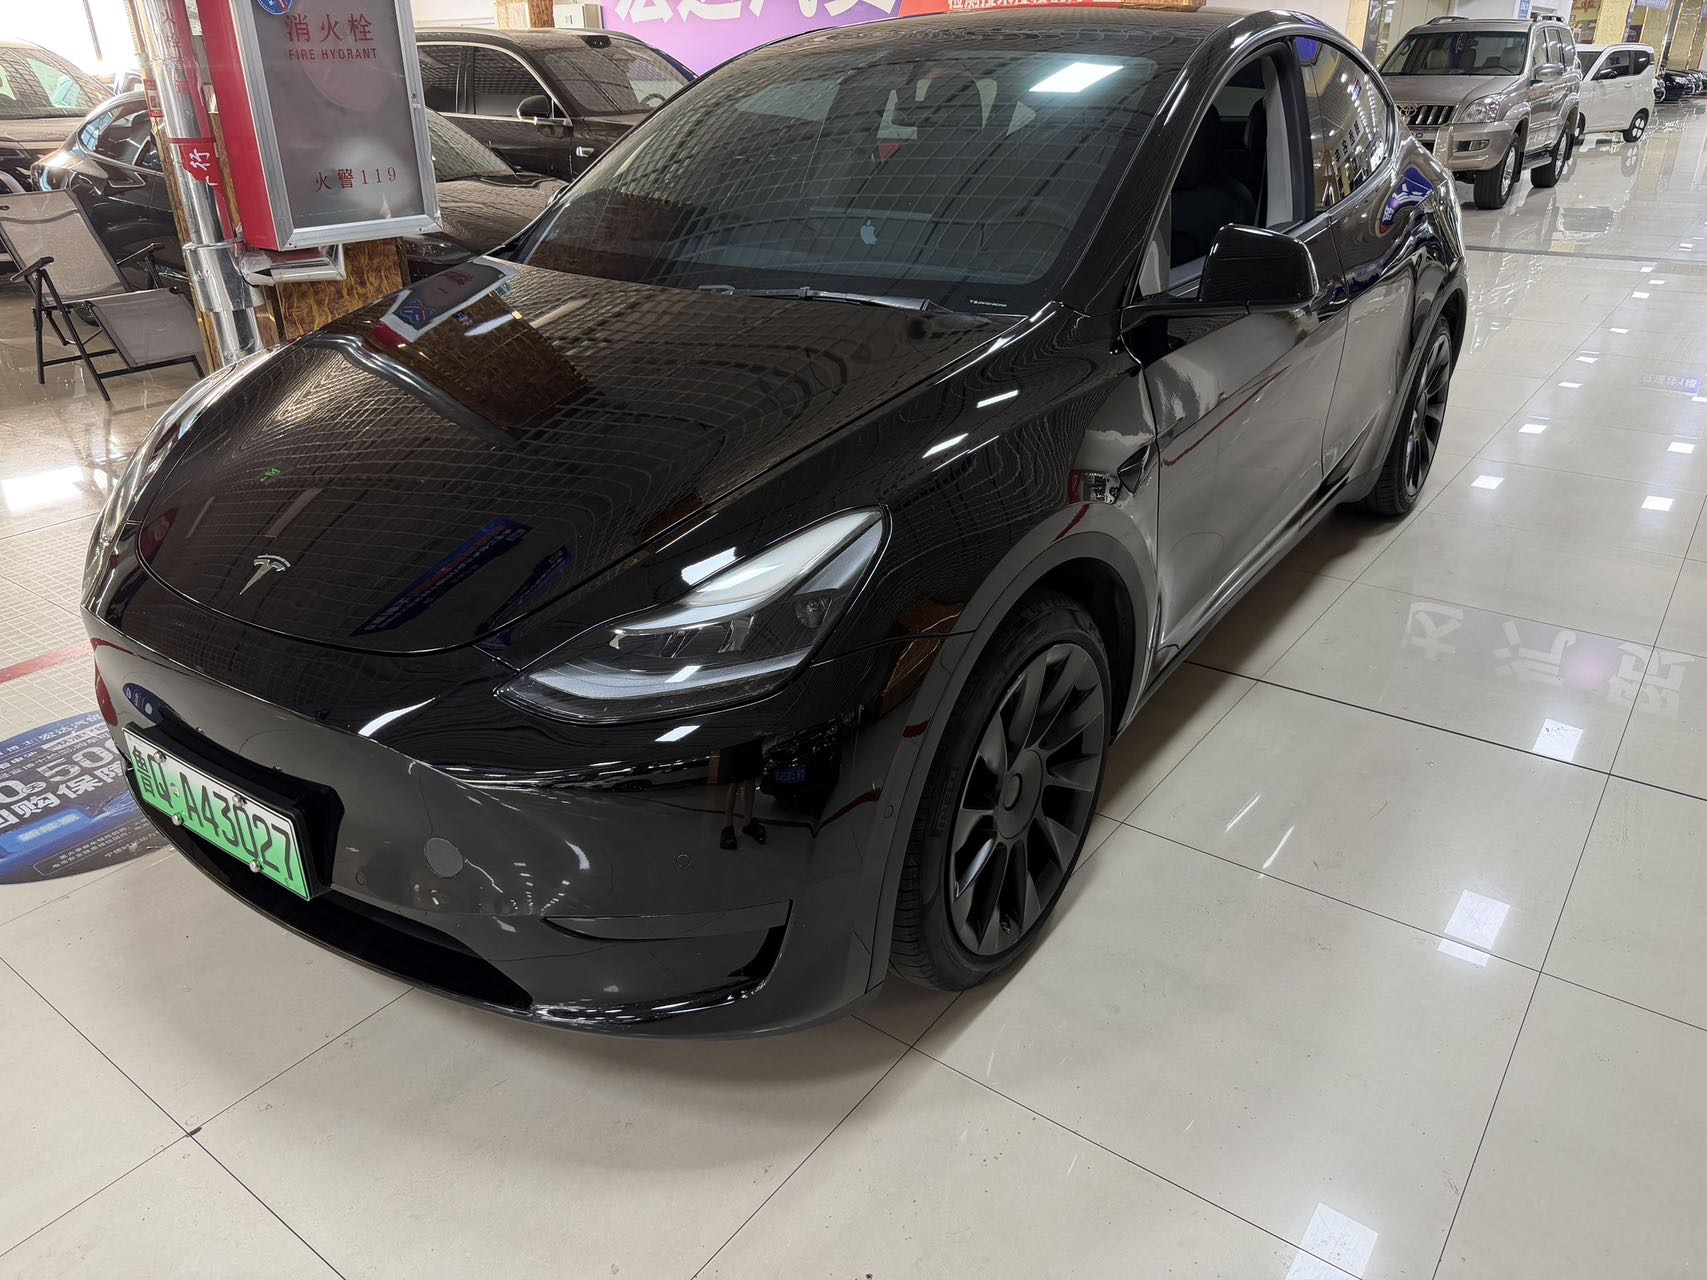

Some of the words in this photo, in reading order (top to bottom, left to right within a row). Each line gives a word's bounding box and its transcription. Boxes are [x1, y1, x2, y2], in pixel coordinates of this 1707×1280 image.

[285, 13, 374, 42] 消火栓
[289, 49, 316, 60] FIRE
